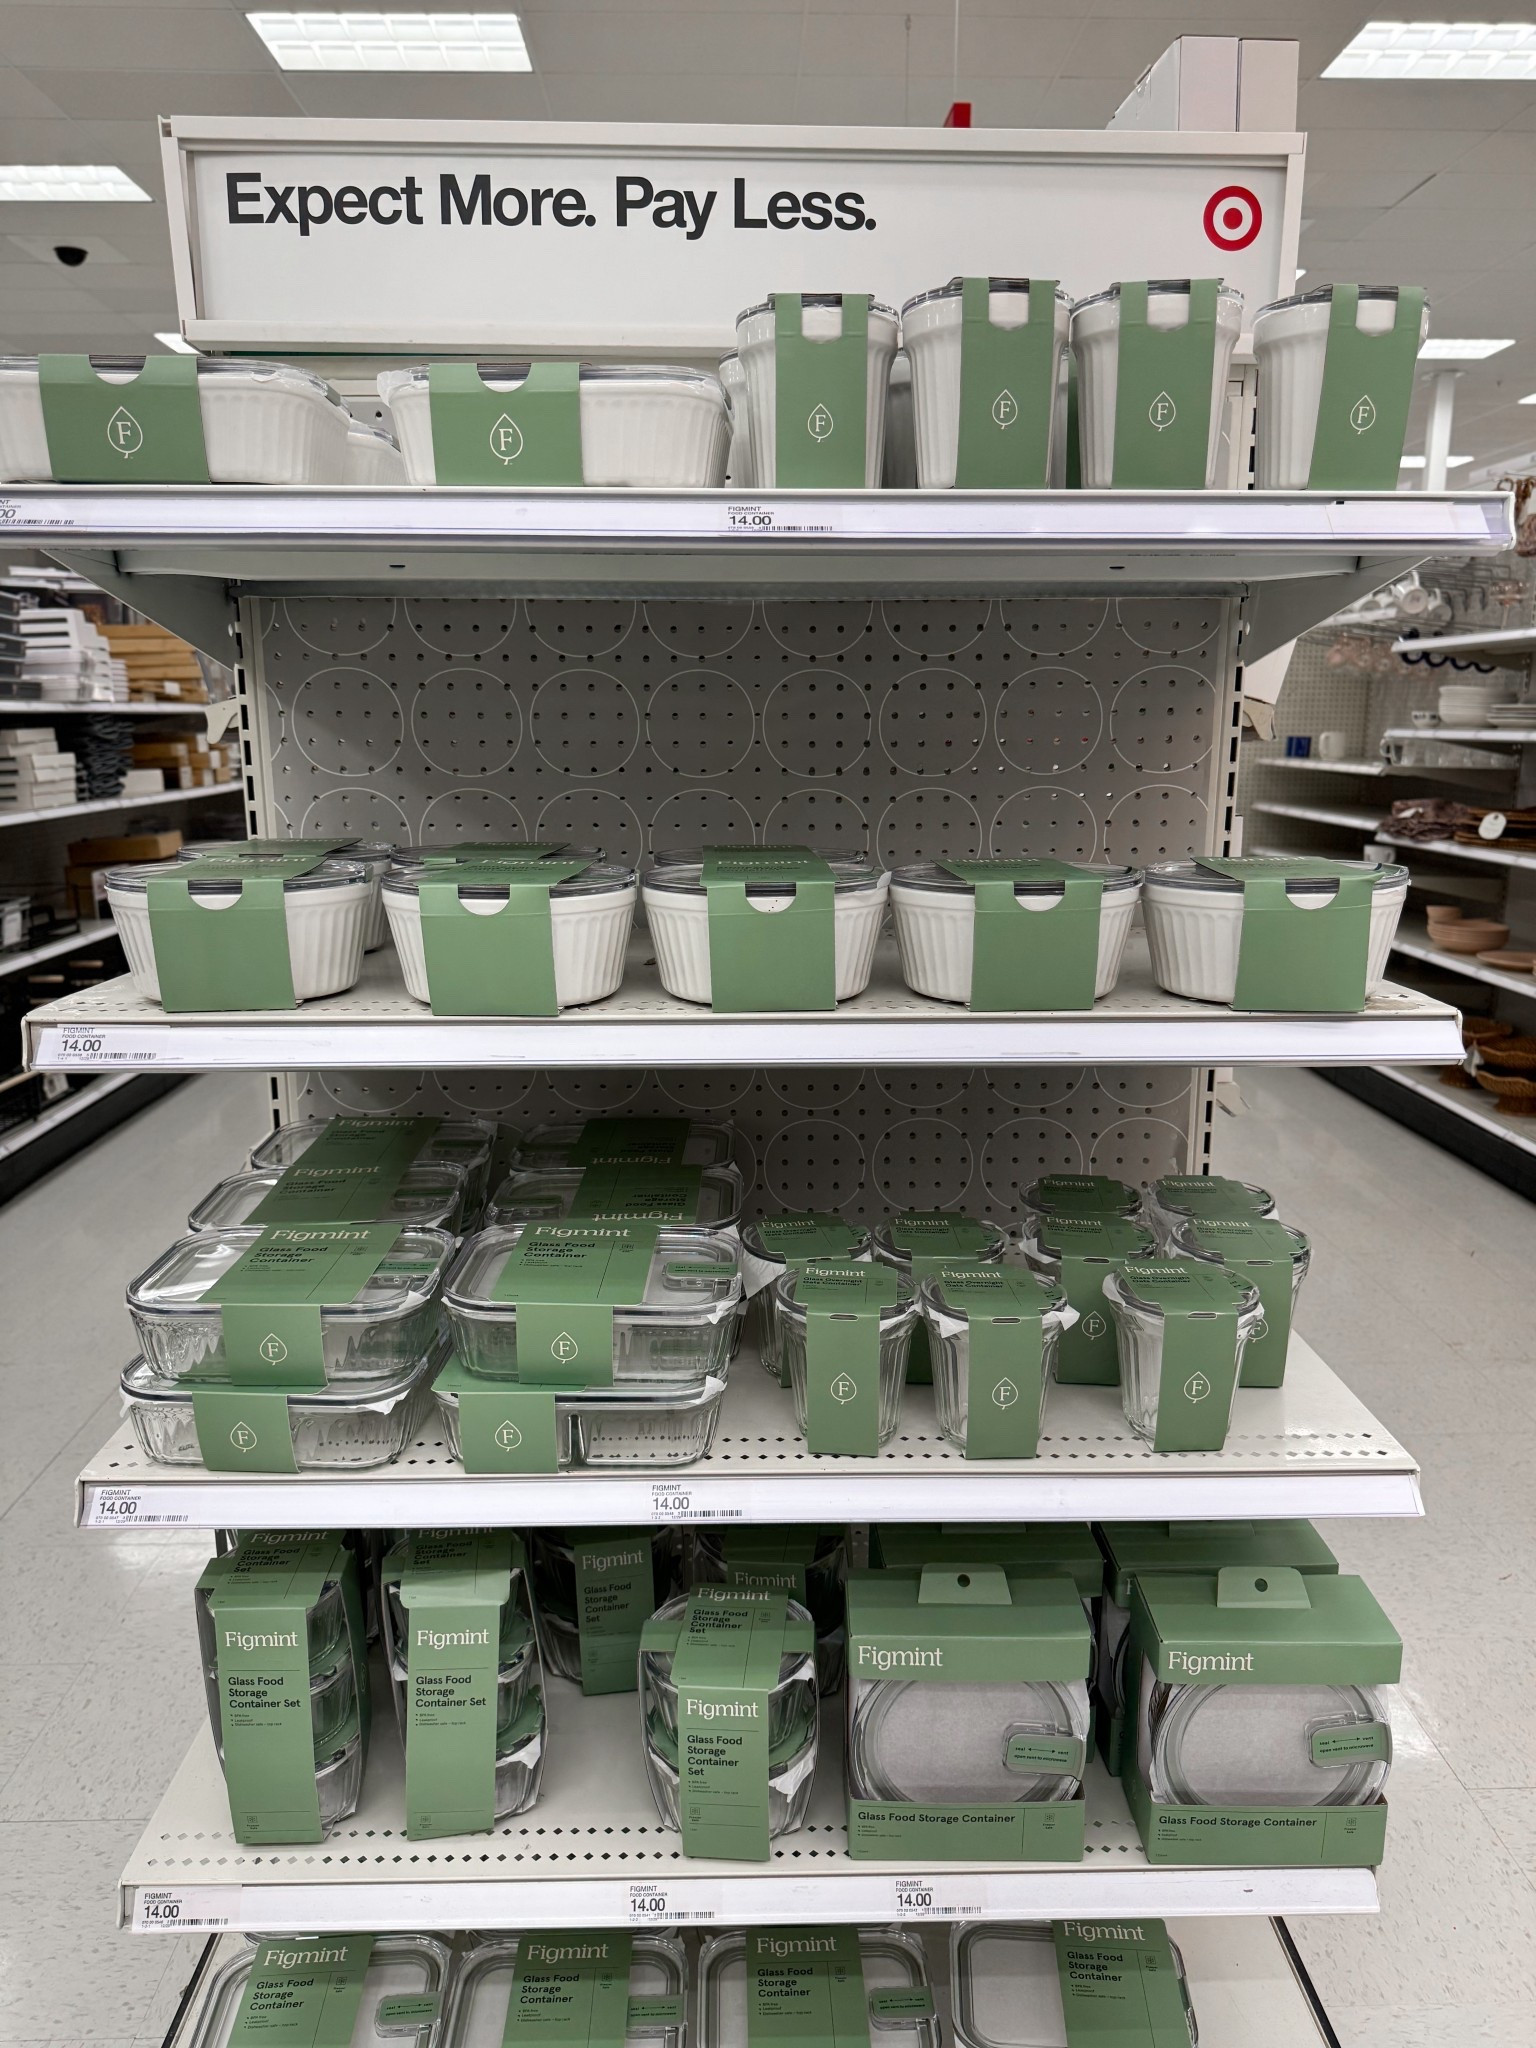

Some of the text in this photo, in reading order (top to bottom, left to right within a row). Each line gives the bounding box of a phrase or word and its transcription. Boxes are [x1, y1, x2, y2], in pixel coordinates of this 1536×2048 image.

[226, 172, 876, 240] Expect More. Pay Less.
[999, 398, 1012, 420] F
[1156, 401, 1169, 422] F
[1356, 404, 1370, 425] F
[814, 414, 827, 433] F
[116, 420, 132, 446] F
[498, 428, 514, 453] F
[730, 516, 772, 526] 14.00
[62, 1040, 102, 1052] 14.00
[294, 1166, 382, 1177] Figmint
[592, 1210, 684, 1222] Figmint
[1046, 1216, 1102, 1226] Figmint
[762, 1220, 816, 1228] Figmint
[1193, 1218, 1251, 1227] Figmint
[270, 1230, 371, 1242] Figmint
[534, 1227, 631, 1237] Figmint
[806, 1267, 866, 1276] Figmint
[1124, 1266, 1188, 1274] Figmint
[1089, 1320, 1100, 1333] F
[268, 1342, 279, 1357] F
[559, 1341, 570, 1355] F
[838, 1381, 850, 1396] F
[1000, 1386, 1011, 1401] F
[1192, 1381, 1204, 1394] F
[238, 1431, 249, 1445] F
[502, 1430, 514, 1443] F
[100, 1502, 137, 1514] 14.00
[653, 1497, 689, 1510] 14.00
[250, 1531, 329, 1544] Figmint
[582, 1549, 644, 1572] Figmint
[609, 1582, 631, 1591] Food
[584, 1595, 618, 1604] Storage
[697, 1588, 772, 1601] Figmint
[585, 1602, 629, 1613] Container
[225, 1632, 299, 1651] Figmint
[417, 1628, 489, 1650] Figmint
[858, 1646, 943, 1670] Figmint
[1168, 1651, 1254, 1675] Figmint
[228, 1677, 284, 1685] Glass Food
[416, 1675, 472, 1684] Glass Food
[228, 1688, 267, 1699] Storage
[416, 1688, 454, 1697] Storage
[229, 1699, 301, 1708] Container Set
[416, 1698, 486, 1707] Container Set
[686, 1699, 759, 1720] Figmint
[687, 1735, 742, 1745] Glass Food
[688, 1746, 726, 1757] Storage
[688, 1757, 739, 1766] Container
[688, 1767, 704, 1776] Set
[858, 1812, 1015, 1824] Glass Food Storage Container
[1159, 1816, 1317, 1828] Glass Food Storage Container
[631, 1898, 665, 1912] 14.00
[897, 1893, 931, 1907] 14.00
[145, 1905, 179, 1918] 14.00
[1064, 1921, 1146, 1941] Figmint
[757, 1937, 837, 1957] Figmint
[264, 1946, 348, 1968] Figmint
[528, 1944, 608, 1963] Figmint
[1067, 1951, 1123, 1962] Glass Food
[758, 1968, 784, 1976] Glass
[1068, 1961, 1108, 1972] Storage
[554, 1974, 580, 1982] Food
[1070, 1971, 1122, 1981] Container
[256, 1978, 314, 1989] Glass Food
[758, 1979, 797, 1988] Storage
[253, 1991, 294, 2000] Storage
[522, 1986, 561, 1994] Storage
[758, 1988, 811, 1997] Container
[250, 2000, 304, 2010] Container
[520, 1995, 573, 2004] Container
